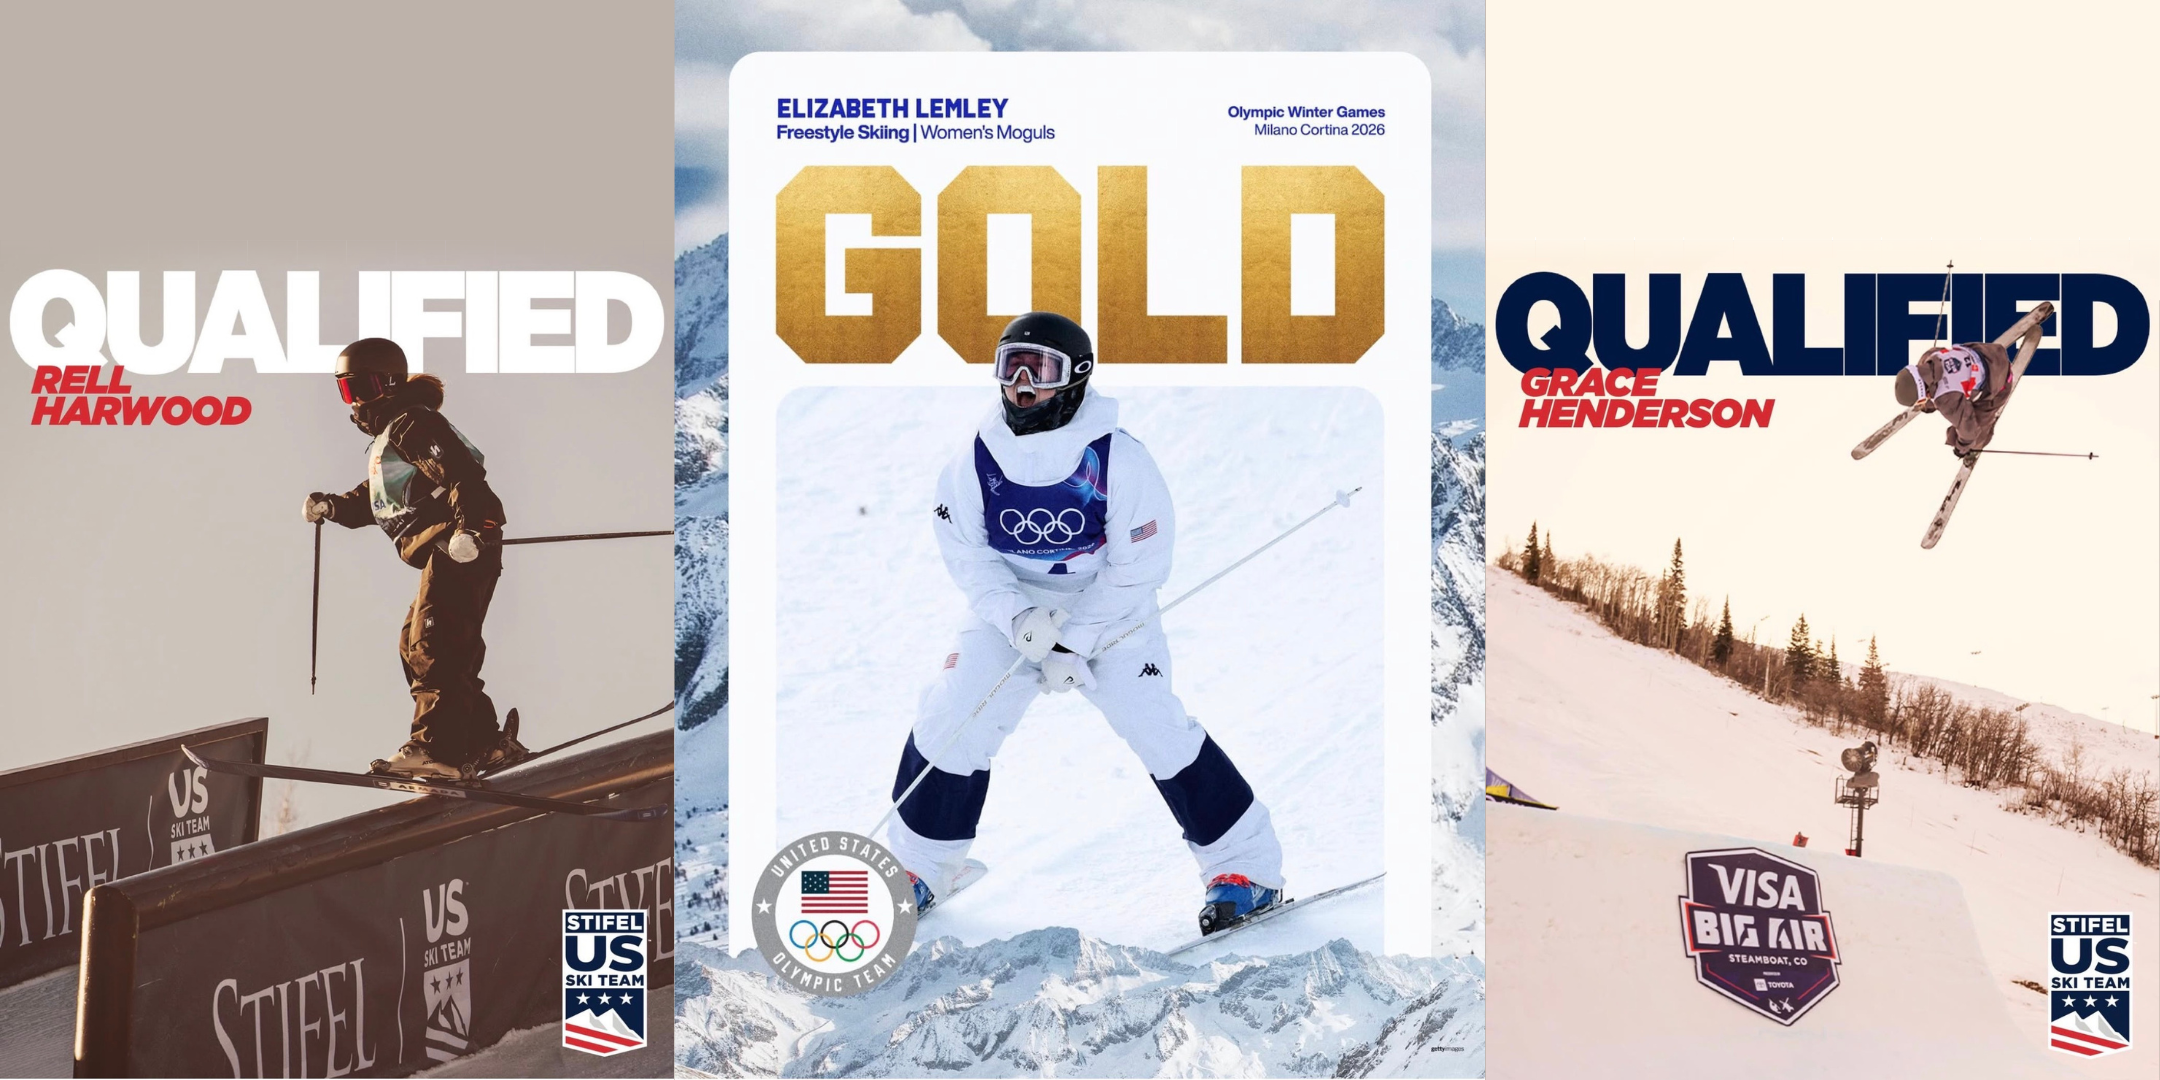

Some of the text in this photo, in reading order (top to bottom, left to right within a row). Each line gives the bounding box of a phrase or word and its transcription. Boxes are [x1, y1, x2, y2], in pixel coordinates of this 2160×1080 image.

[168, 766, 209, 818] US
[170, 815, 211, 839] SKI TEAM
[1707, 863, 1806, 911] VISA
[423, 879, 469, 943] US
[1693, 910, 1828, 951] BIG AIR
[424, 936, 472, 968] SKI TEAM
[1728, 953, 1808, 966] STEAMBOAT, CO
[1767, 981, 1795, 989] TOYOTA
[212, 957, 377, 1079] STIFEL
